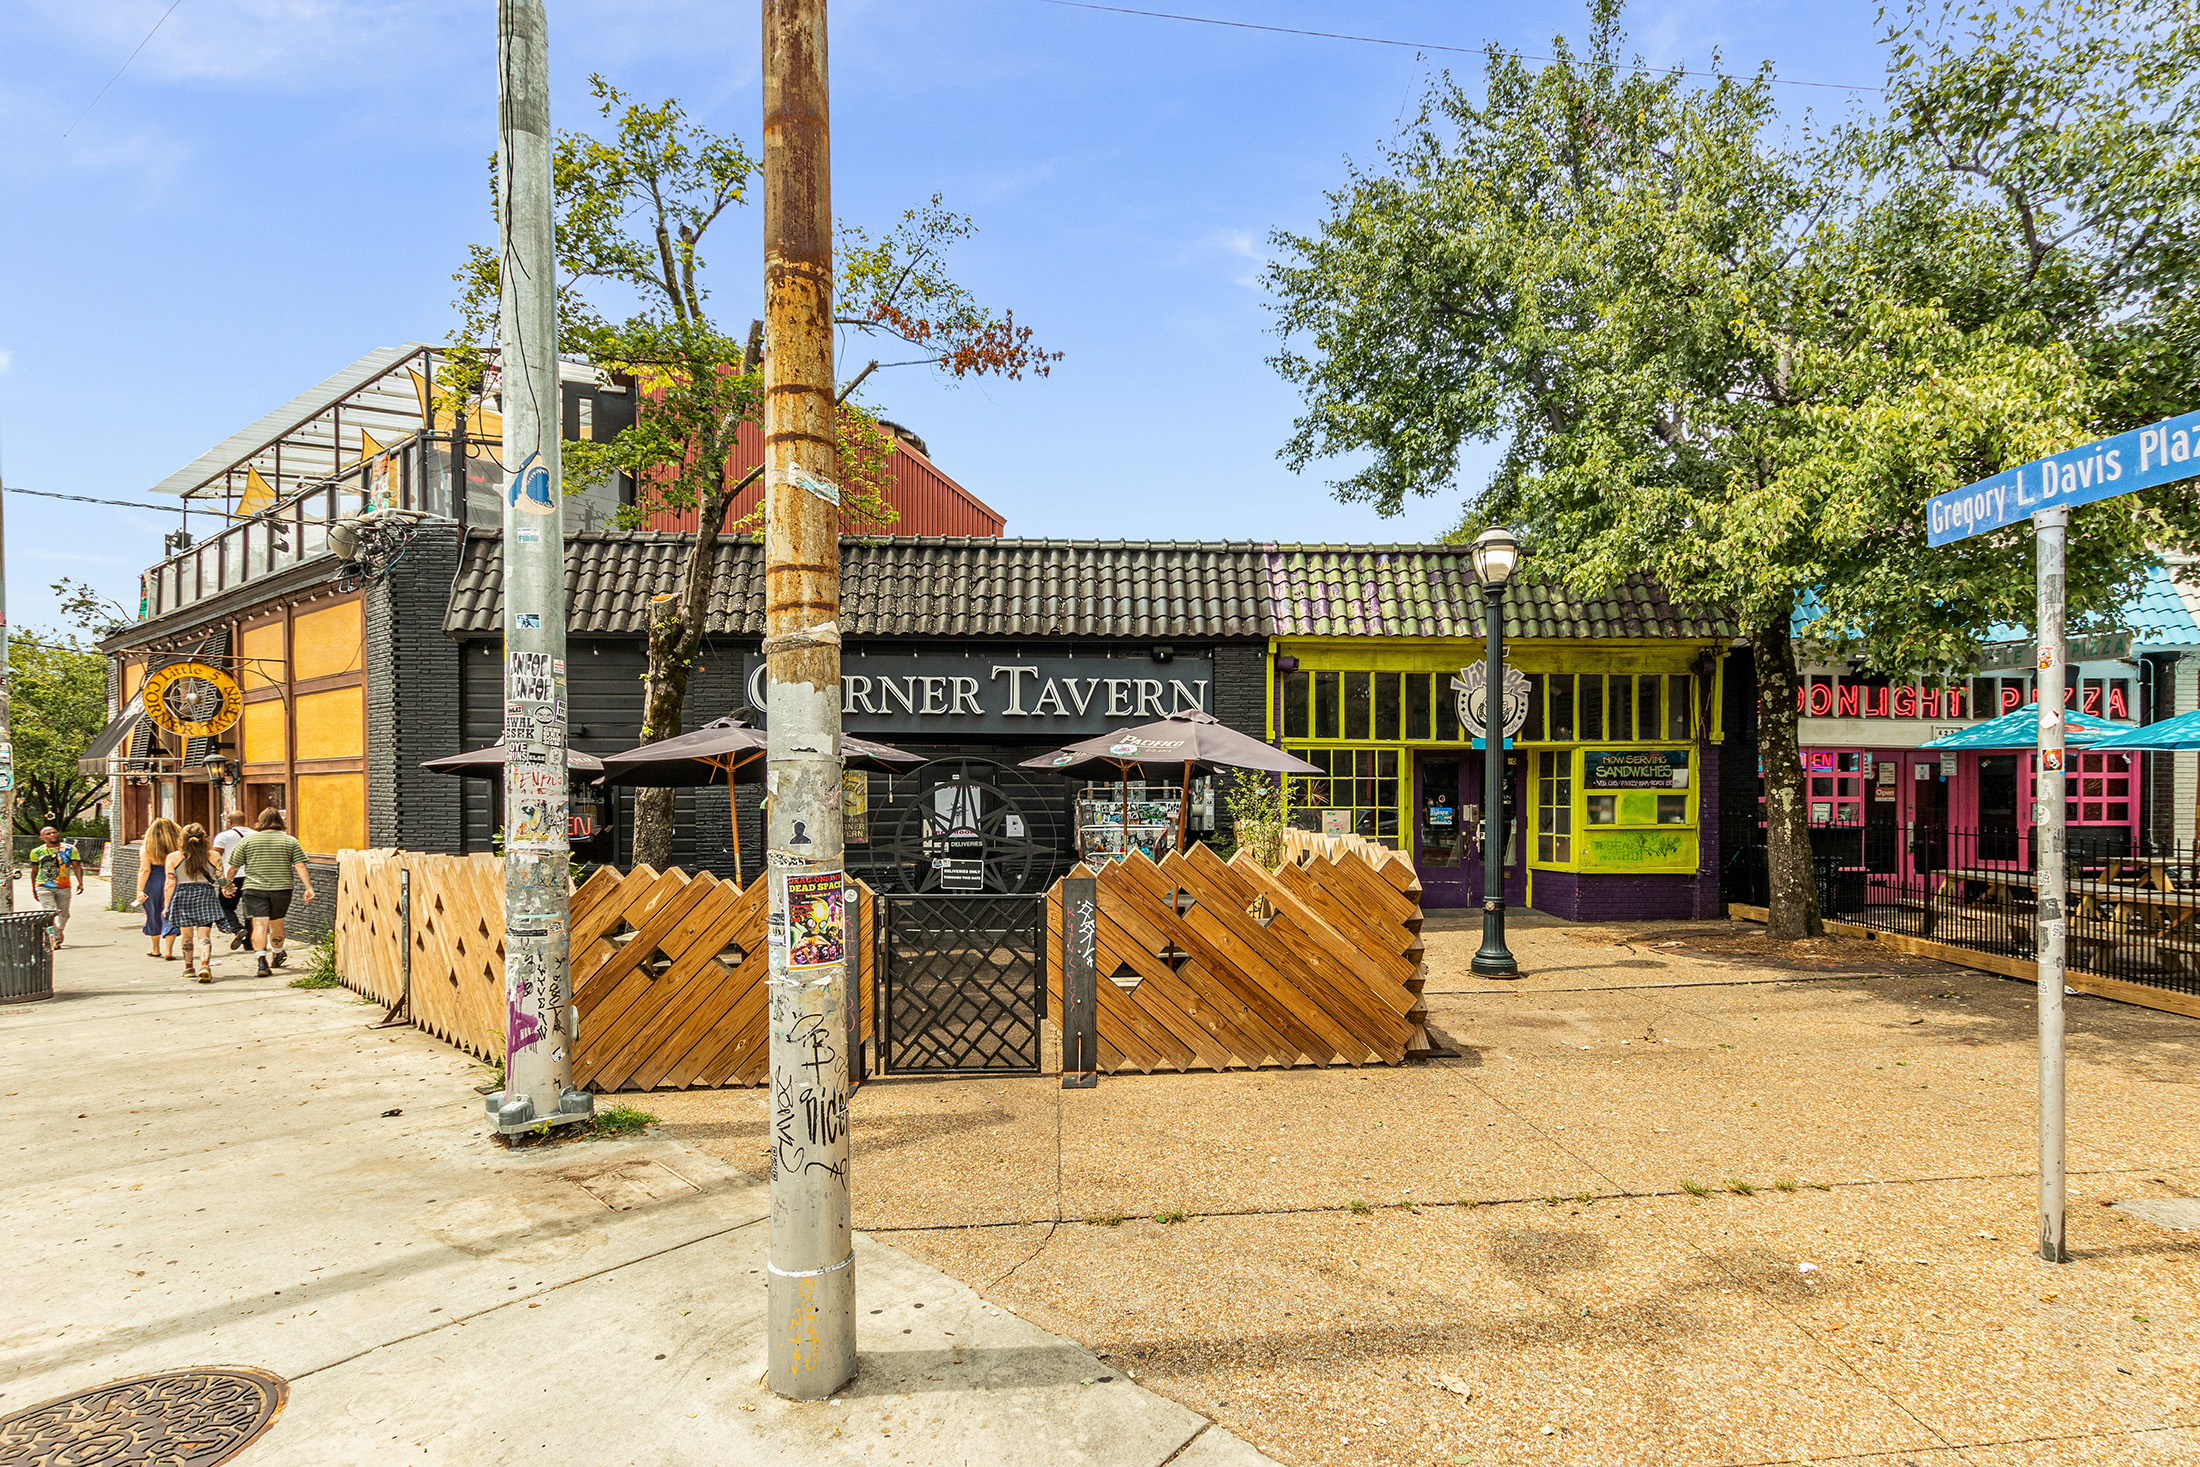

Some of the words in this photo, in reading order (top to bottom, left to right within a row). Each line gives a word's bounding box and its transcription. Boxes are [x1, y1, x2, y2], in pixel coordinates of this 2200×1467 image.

[1931, 485, 2007, 535] Gregory
[2016, 470, 2035, 507] L.
[2041, 445, 2122, 500] Davis
[2071, 638, 2125, 659] PIZZA
[158, 663, 202, 681] Little
[209, 671, 222, 681] 5
[990, 664, 1209, 717] TAVERN
[145, 681, 194, 735] CORNER
[202, 685, 241, 734] TAVERN
[1119, 734, 1185, 747] PACIFICO
[1602, 755, 1625, 764] NOW
[1626, 755, 1667, 764] SERVING
[1811, 754, 1832, 767] EN
[1596, 765, 1674, 778] SANDWICHES
[567, 816, 592, 836] EN
[788, 883, 816, 893] DEAD
